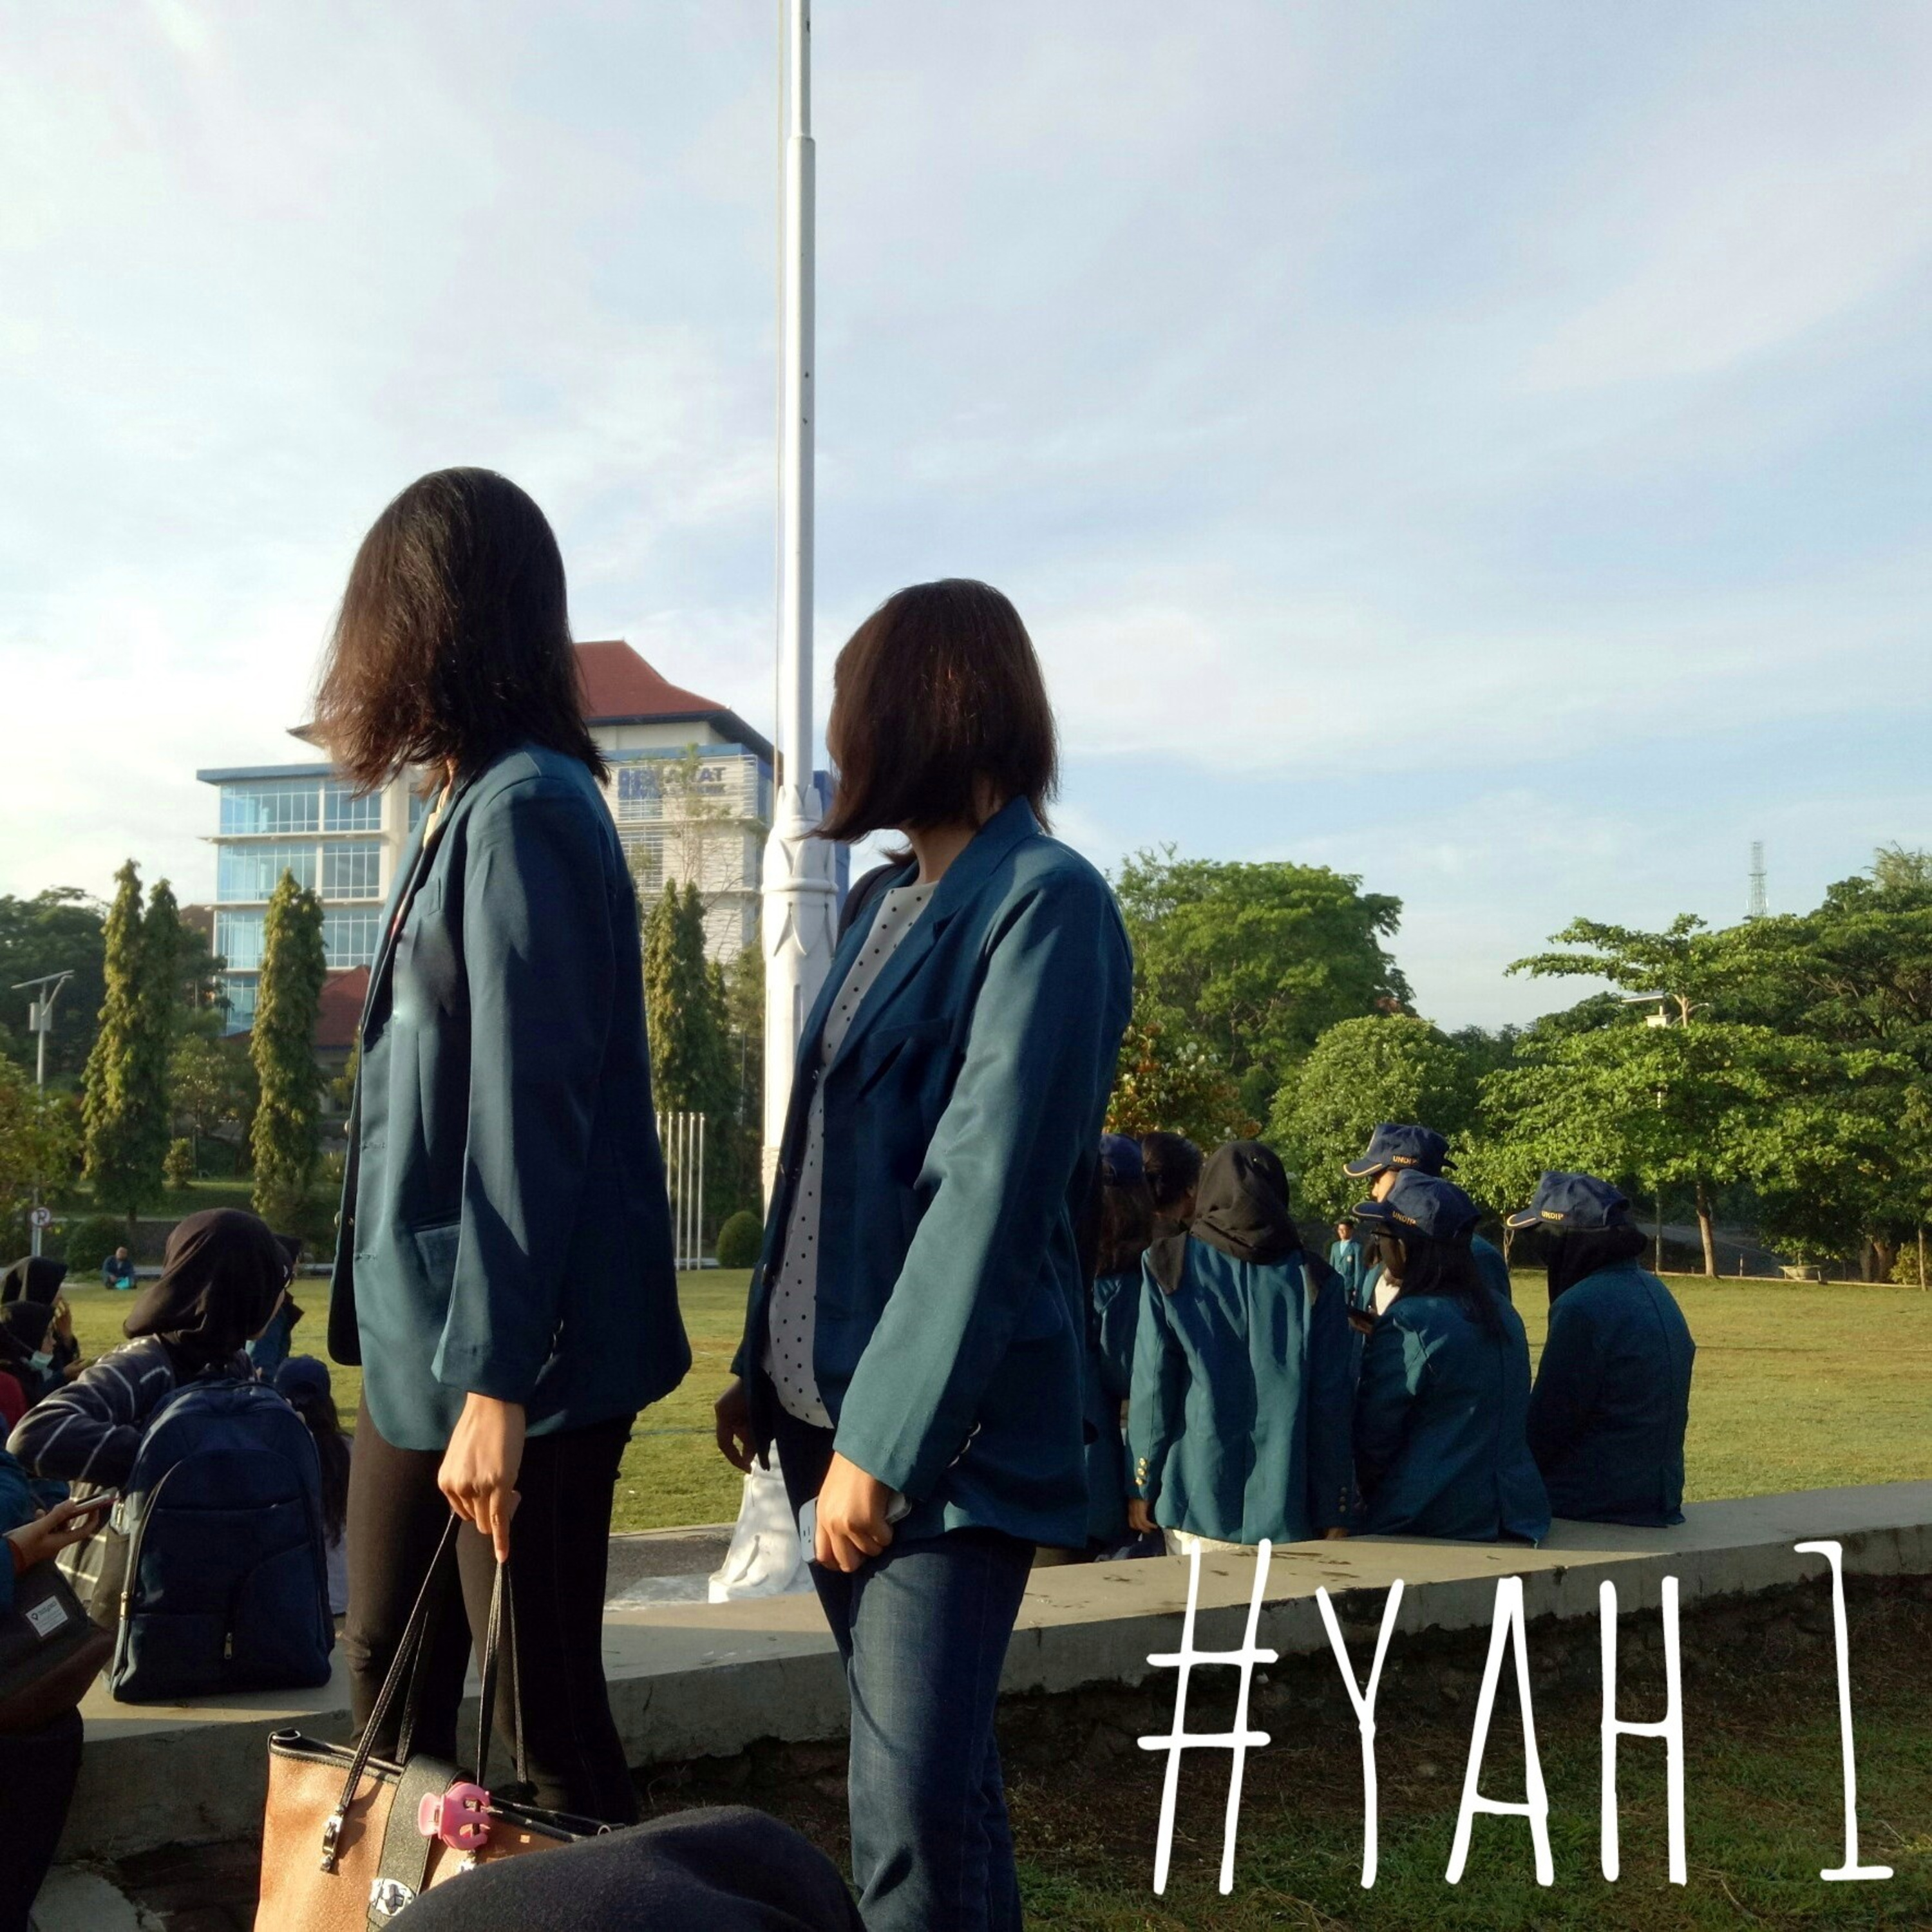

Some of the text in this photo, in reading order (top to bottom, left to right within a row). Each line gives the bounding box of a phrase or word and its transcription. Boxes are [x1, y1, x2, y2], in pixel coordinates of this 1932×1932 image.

[1392, 1155, 1418, 1164] UNDIP
[1392, 1210, 1417, 1225] UNDIP
[1541, 1210, 1564, 1220] UNDIP
